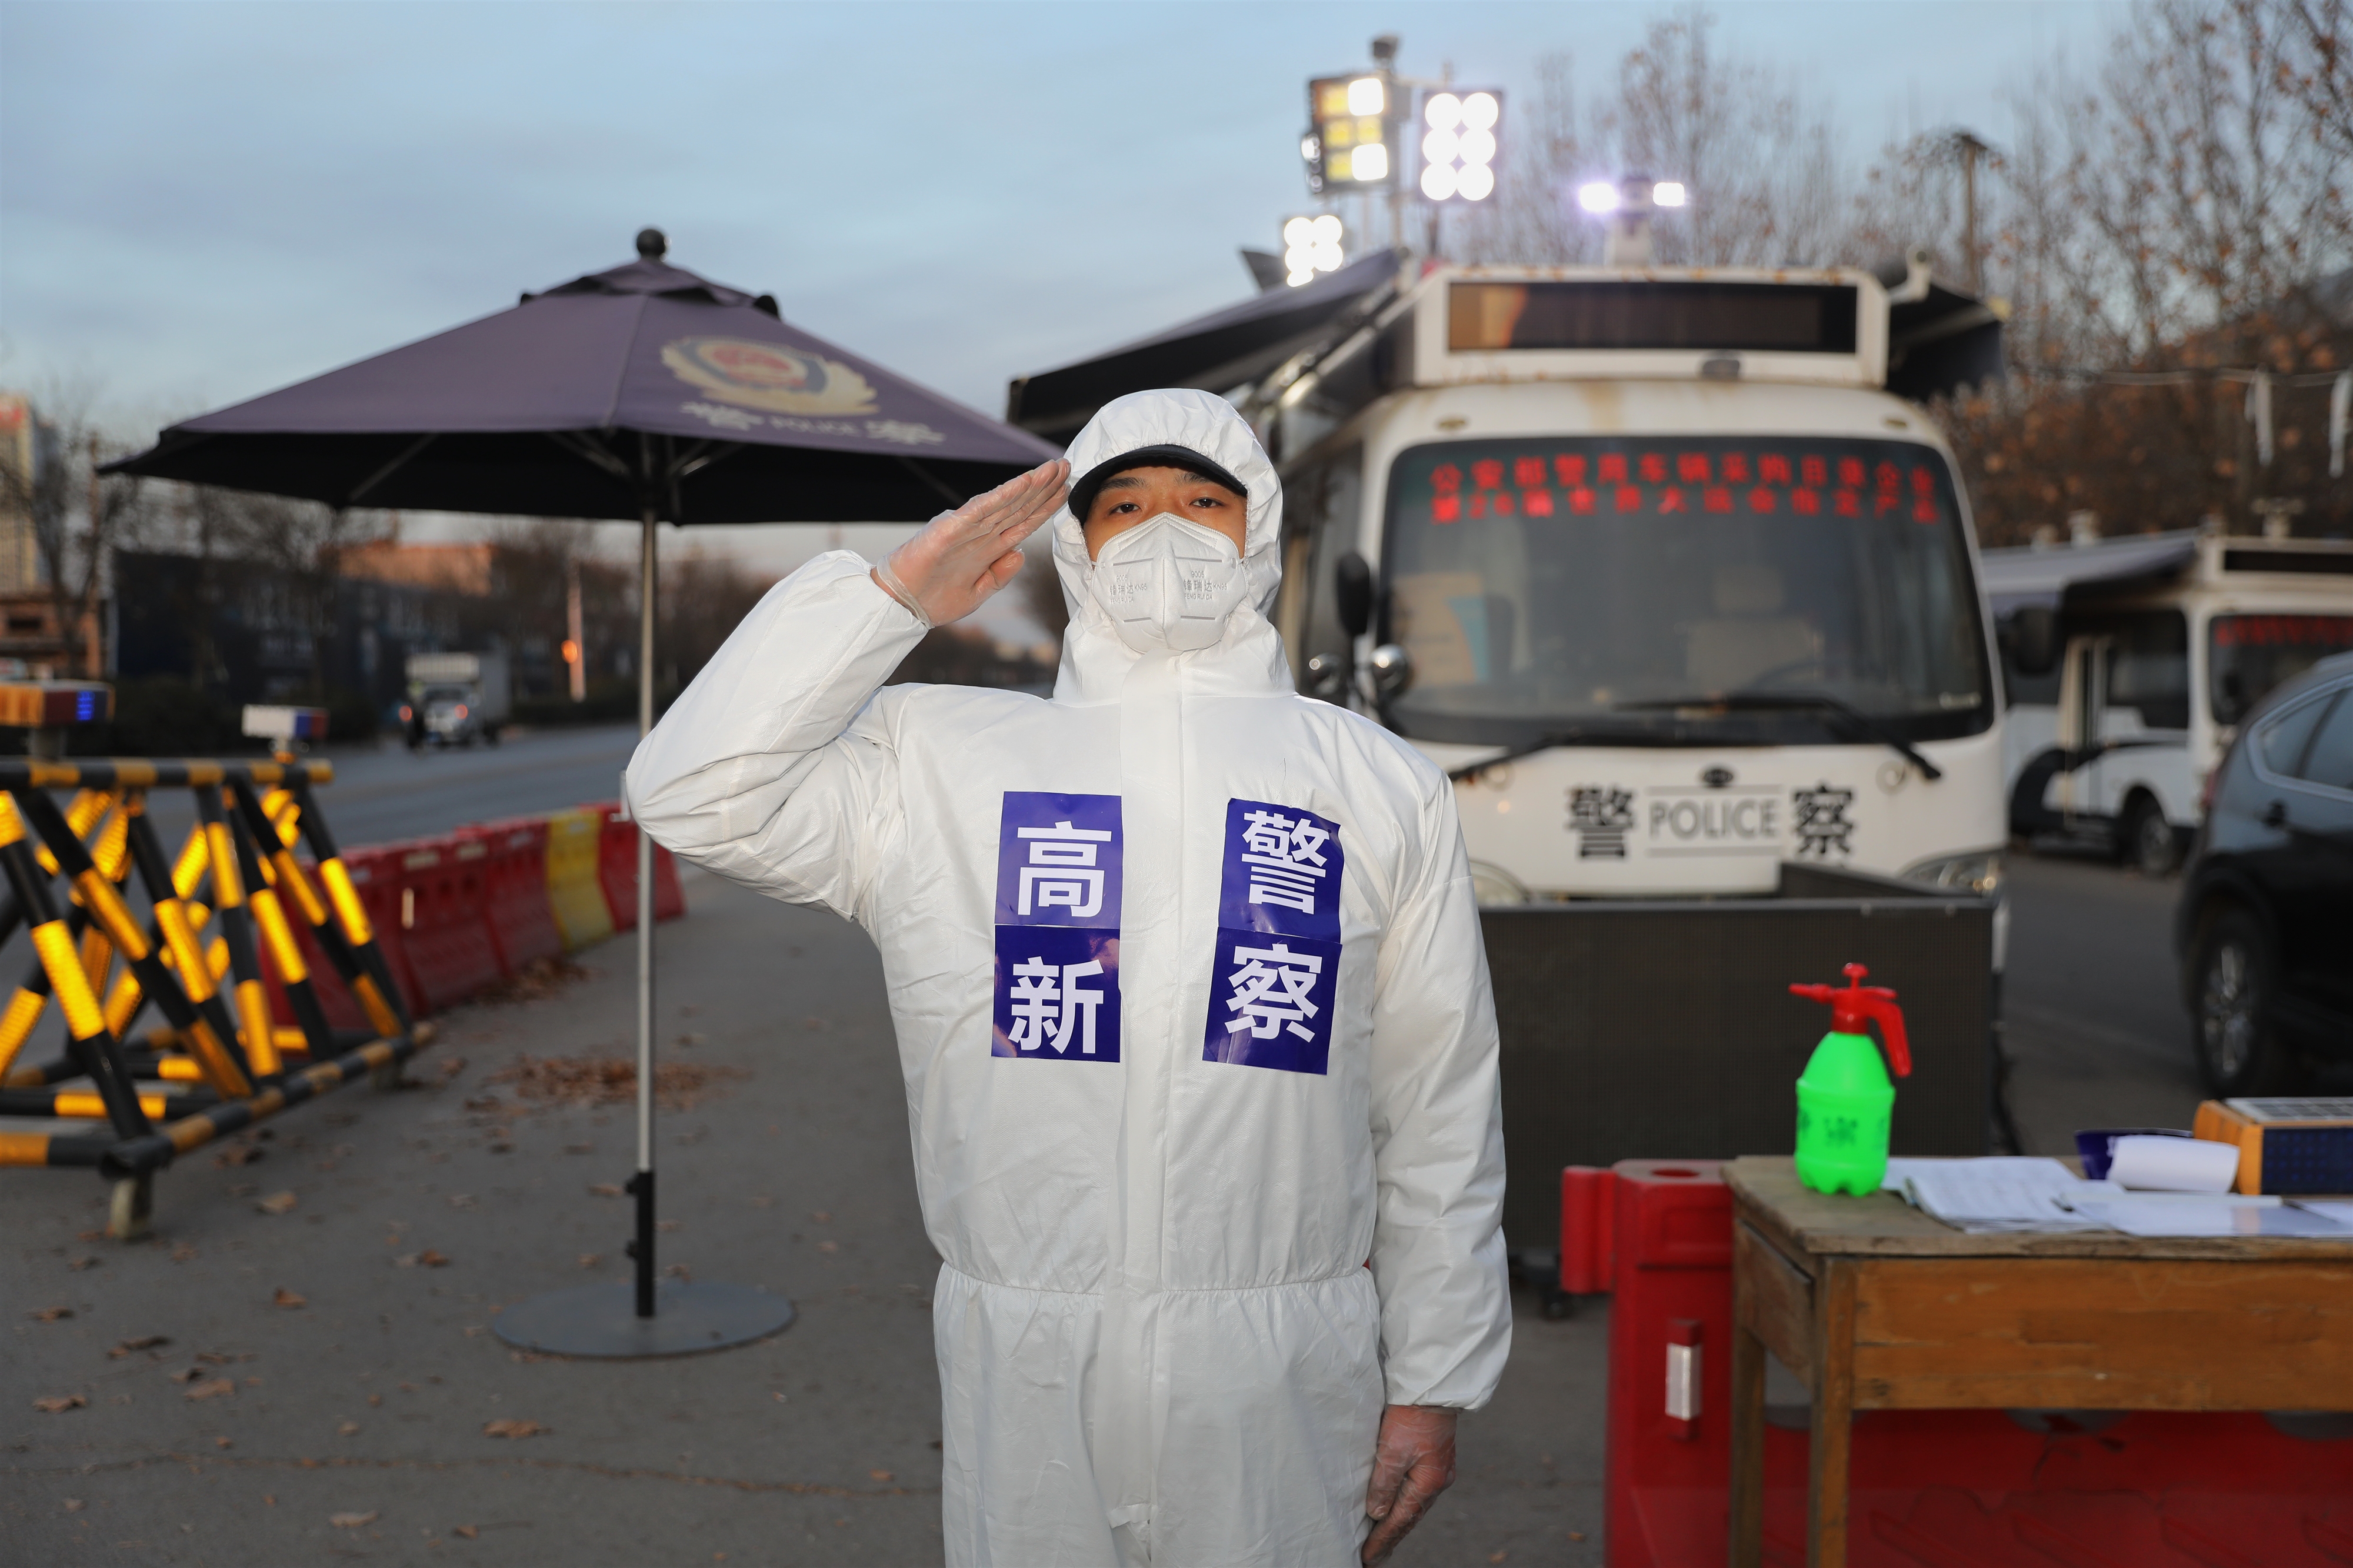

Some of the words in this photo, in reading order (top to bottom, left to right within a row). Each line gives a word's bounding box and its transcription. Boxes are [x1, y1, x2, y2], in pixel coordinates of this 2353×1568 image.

[1224, 810, 1330, 1043] 警察
[1567, 786, 1634, 858] 警
[1649, 800, 1777, 839] POLICE
[1794, 782, 1855, 855] 察
[1008, 820, 1112, 1054] 高新
